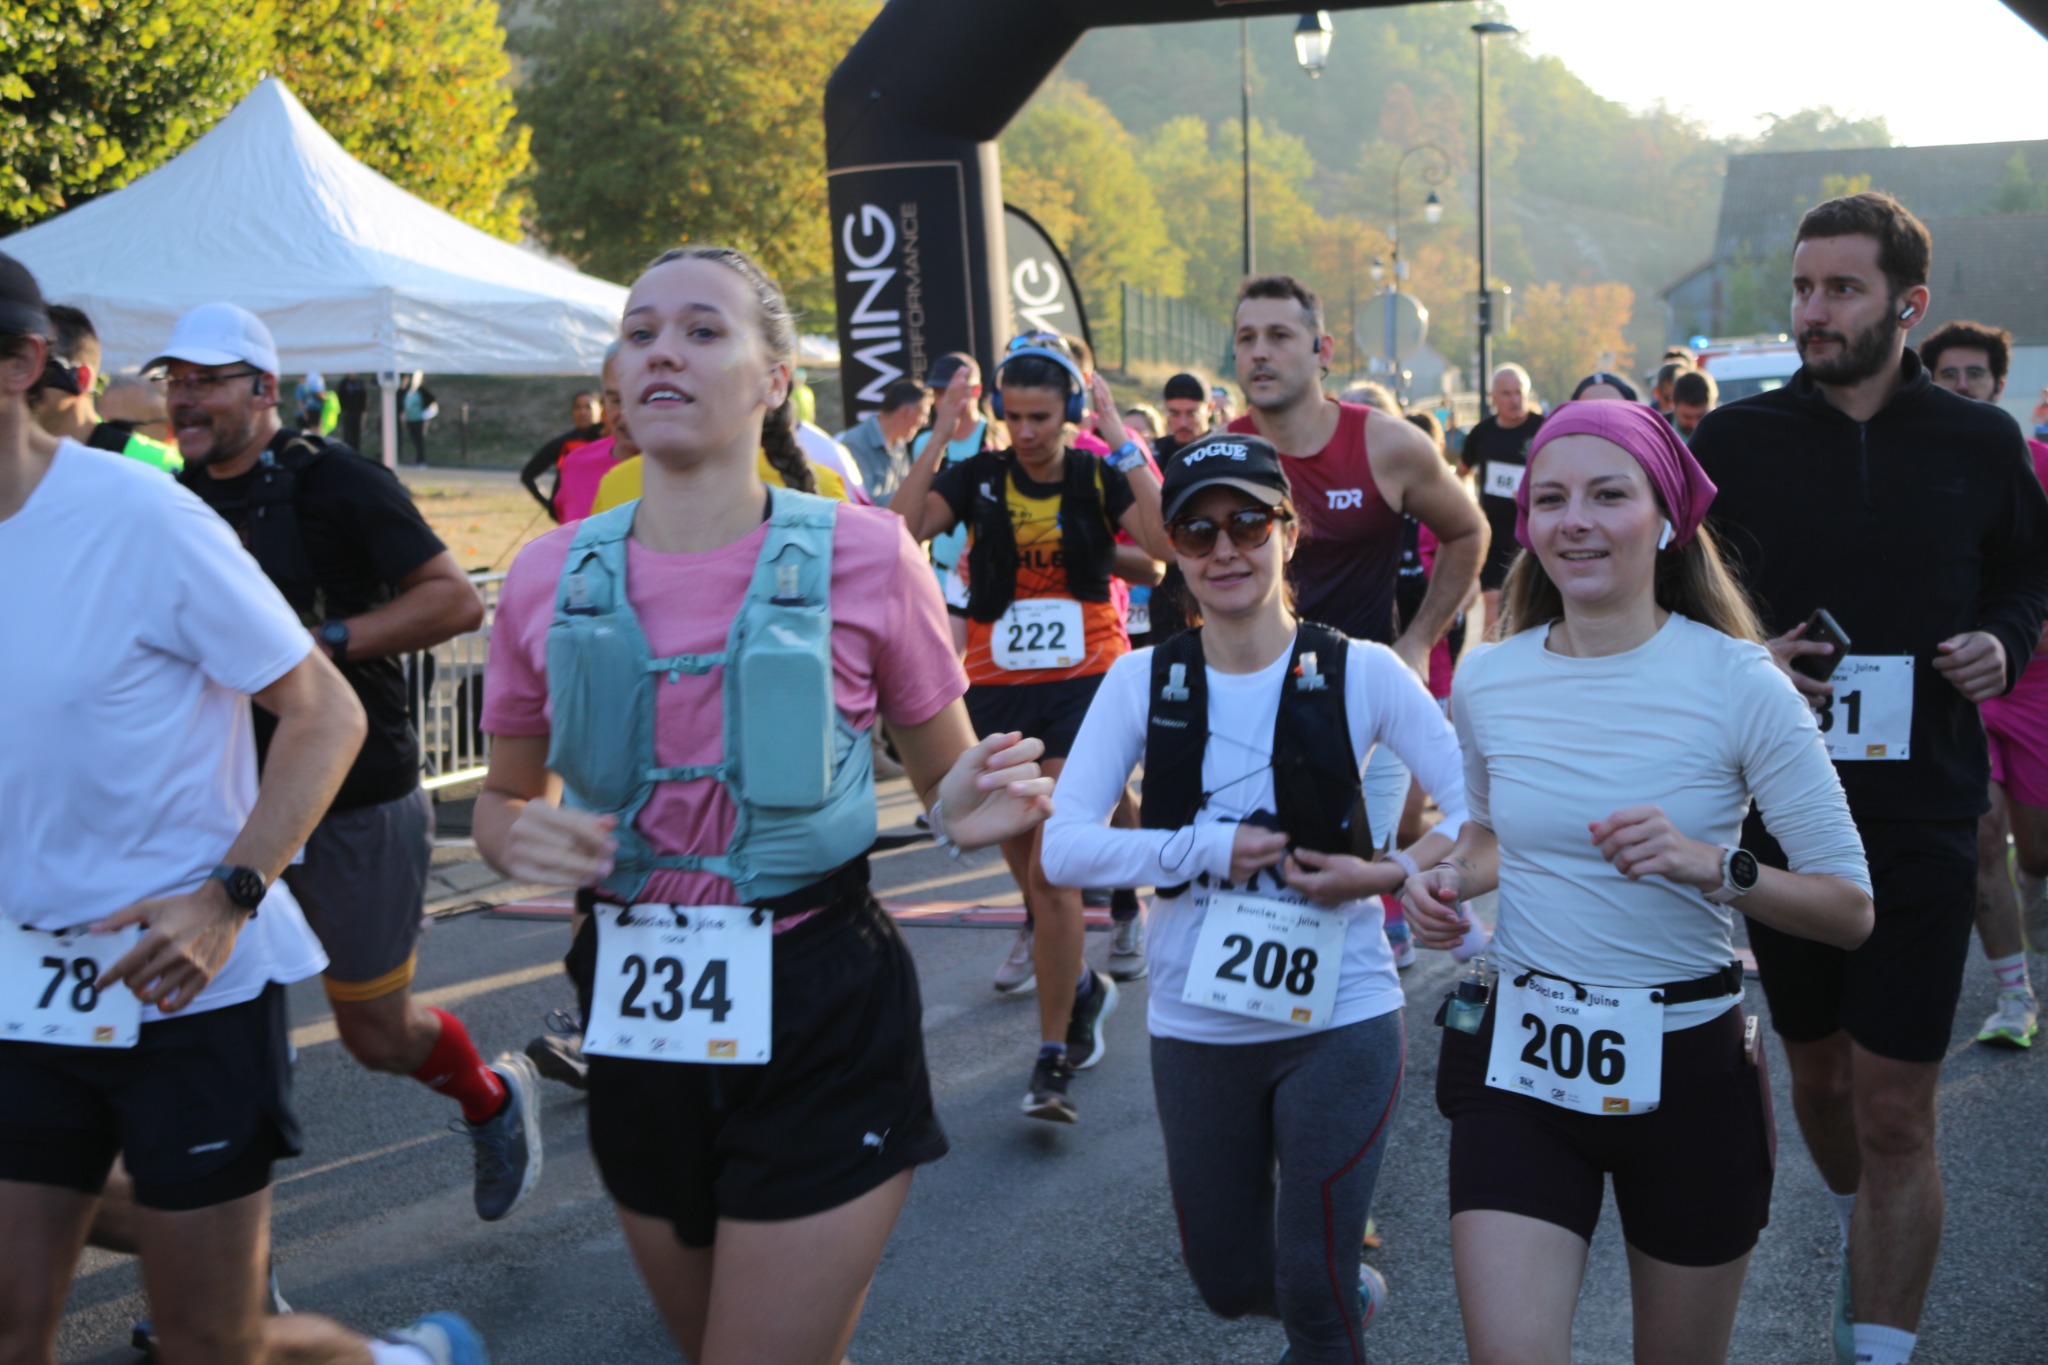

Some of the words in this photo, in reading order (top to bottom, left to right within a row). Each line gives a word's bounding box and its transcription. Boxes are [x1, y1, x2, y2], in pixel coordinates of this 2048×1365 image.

[1183, 442, 1249, 467] VOGUE
[1326, 488, 1364, 510] TDR
[1008, 621, 1067, 653] 222
[36, 955, 98, 1014] 78
[619, 954, 733, 1023] 234
[1215, 933, 1318, 996] 208
[1520, 1012, 1626, 1086] 206
